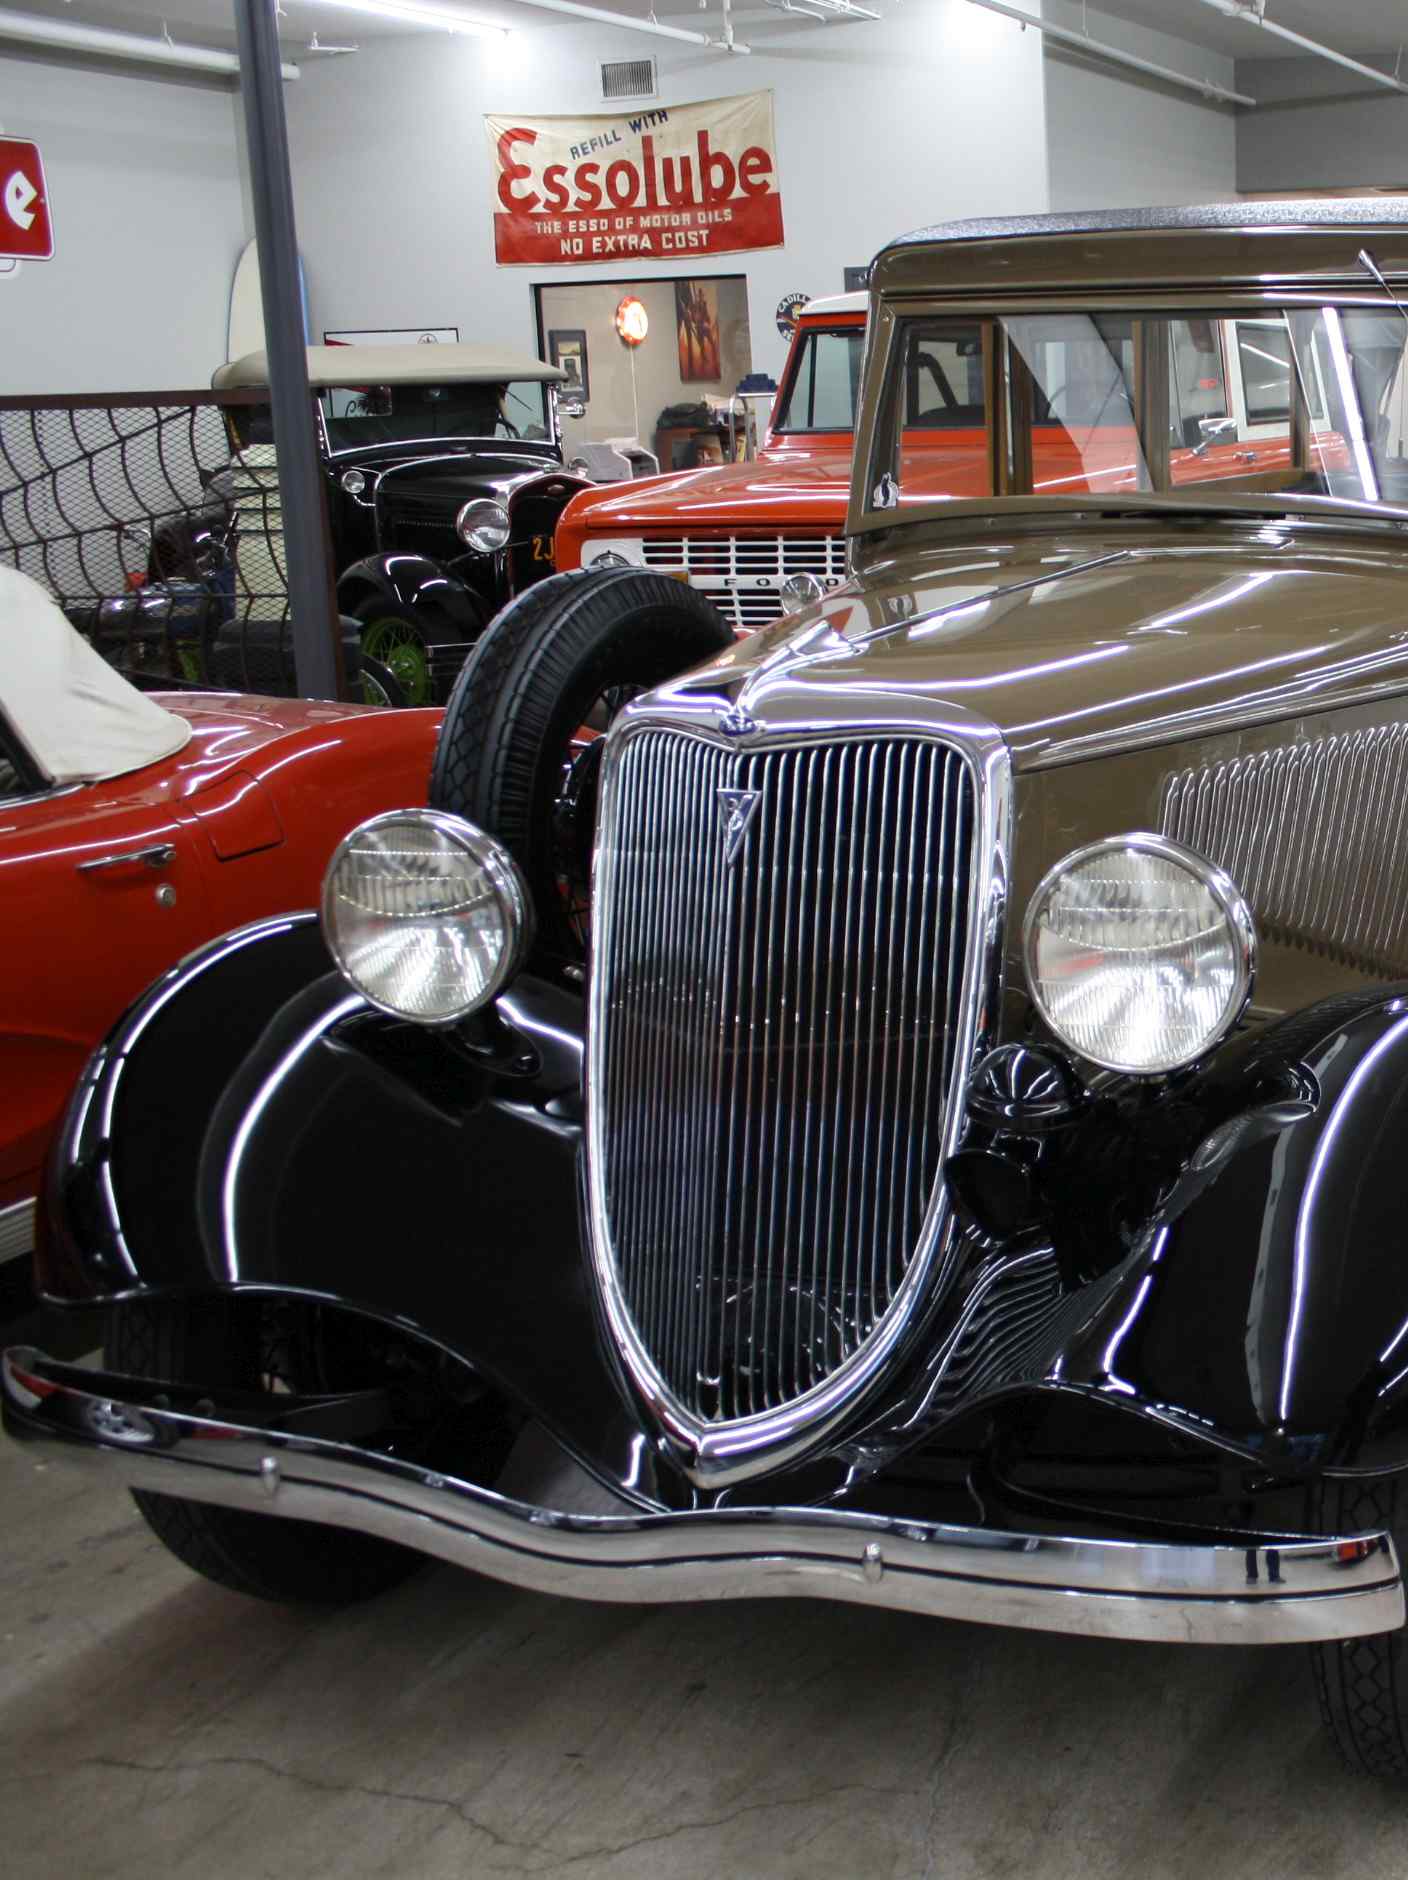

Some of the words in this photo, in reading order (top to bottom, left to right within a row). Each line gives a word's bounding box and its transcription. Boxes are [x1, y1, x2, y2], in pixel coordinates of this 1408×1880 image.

[570, 130, 622, 160] REFILL
[628, 110, 668, 135] WITH
[496, 127, 773, 213] Essolube
[535, 221, 562, 234] THE
[569, 219, 608, 233] ESSO
[615, 217, 634, 231] OF
[640, 215, 691, 229] MOTOR
[697, 208, 733, 225] OILS
[560, 239, 584, 255] NO
[592, 231, 653, 254] EXTRA
[661, 229, 710, 249] COST
[724, 577, 839, 587] FOD
